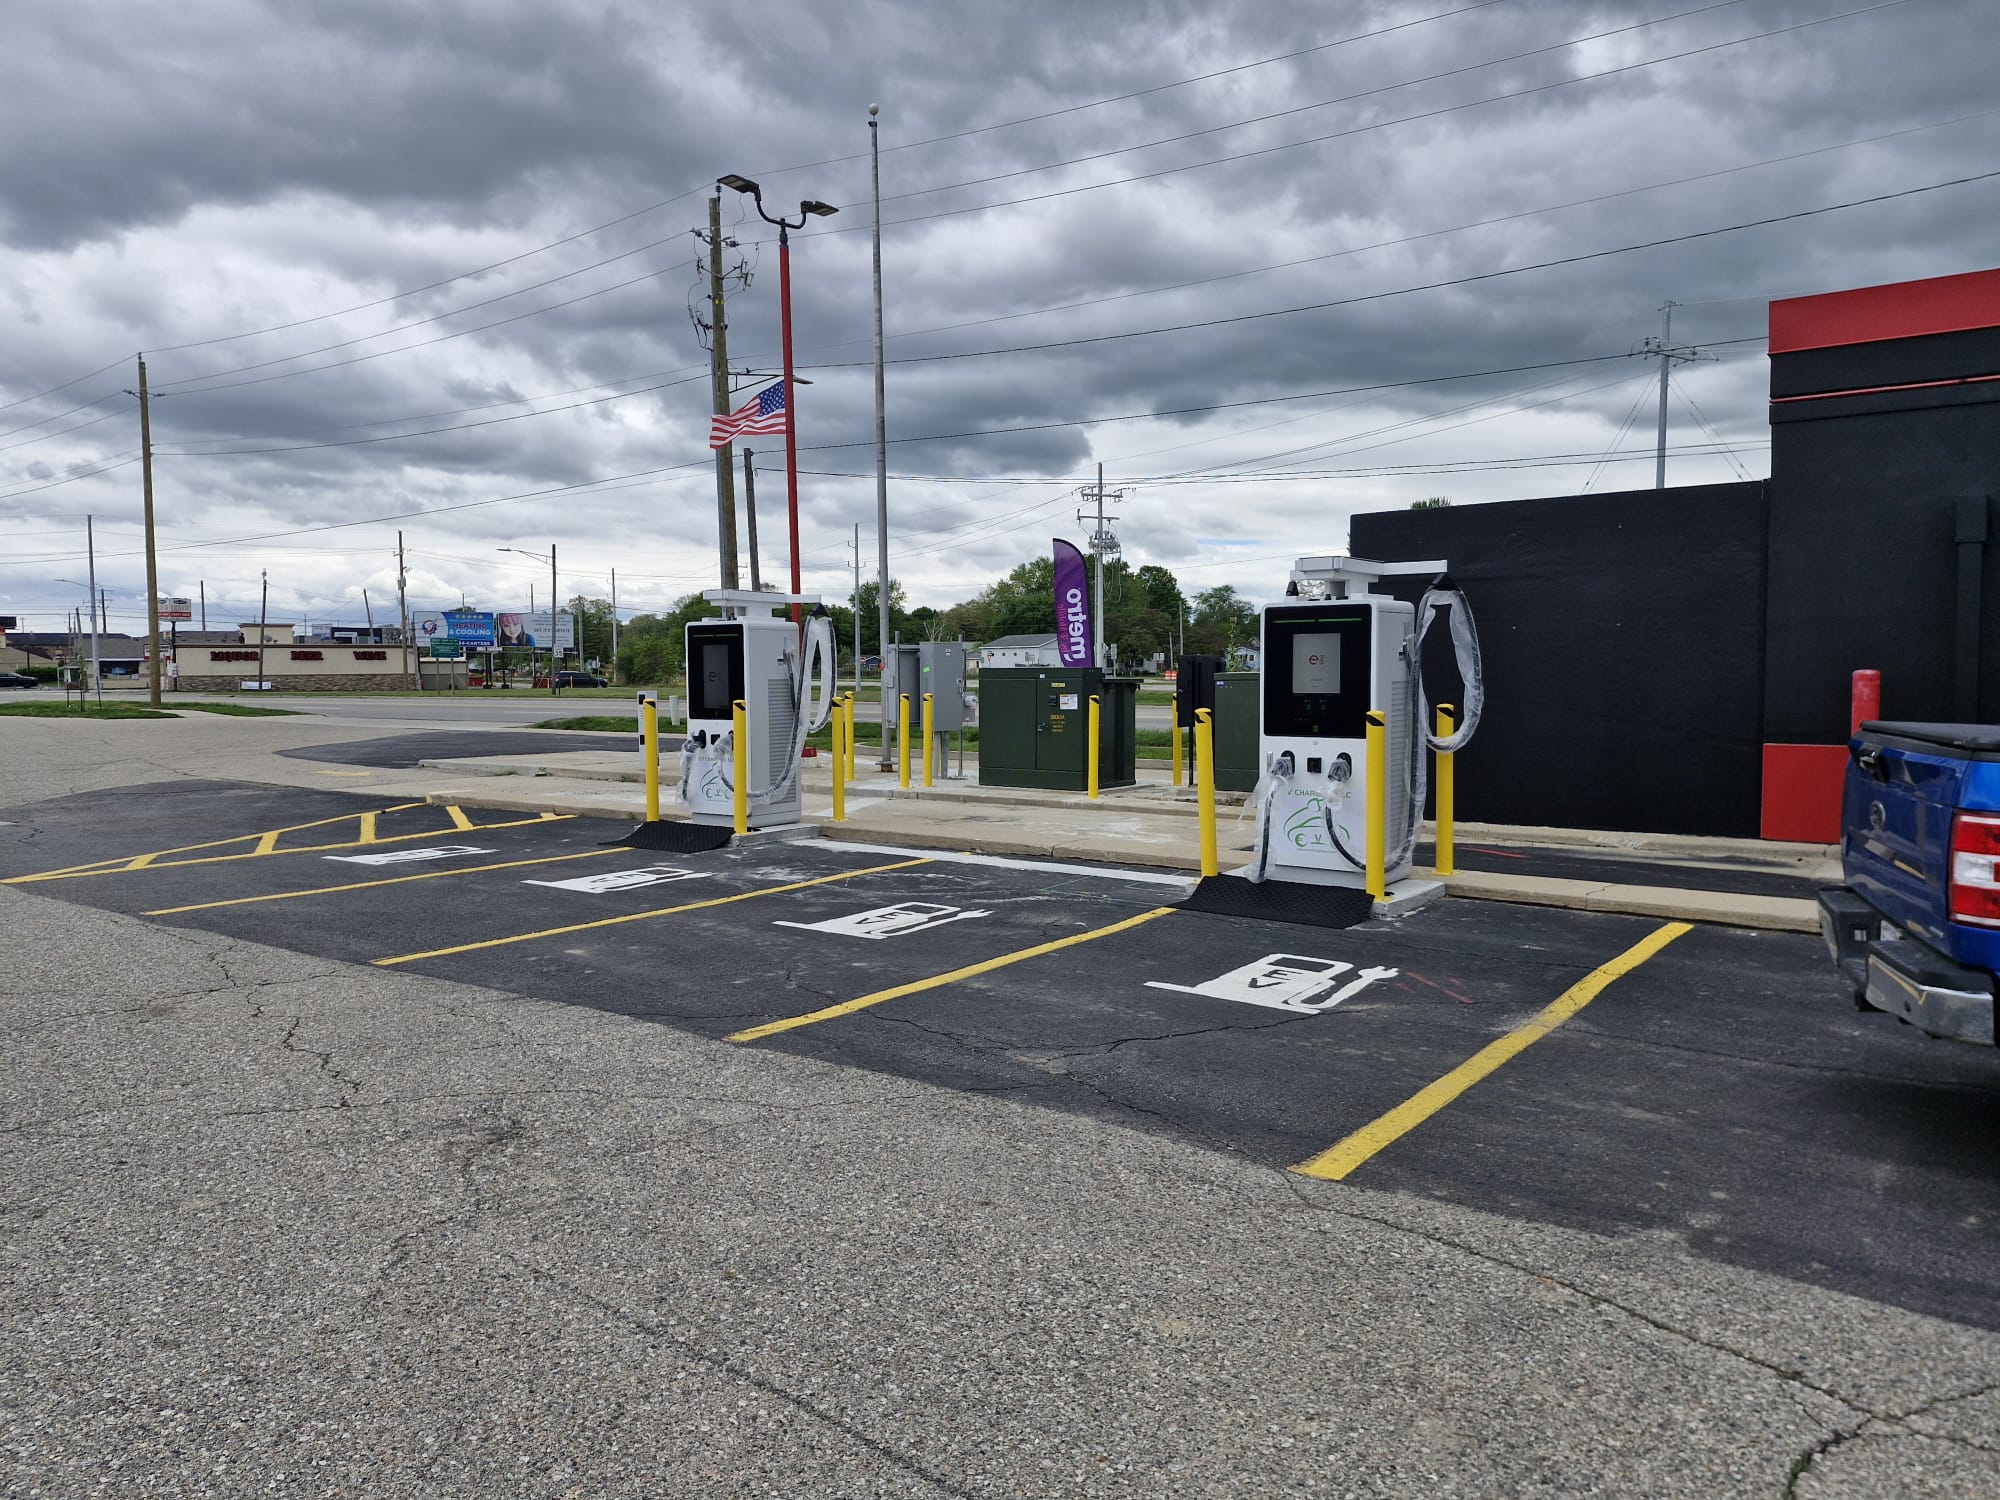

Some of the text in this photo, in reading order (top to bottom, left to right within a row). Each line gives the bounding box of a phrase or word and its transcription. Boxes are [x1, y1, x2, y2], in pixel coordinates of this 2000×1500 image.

[210, 651, 387, 662] LIQUOR BEER WINE
[1247, 969, 1304, 989] EV
